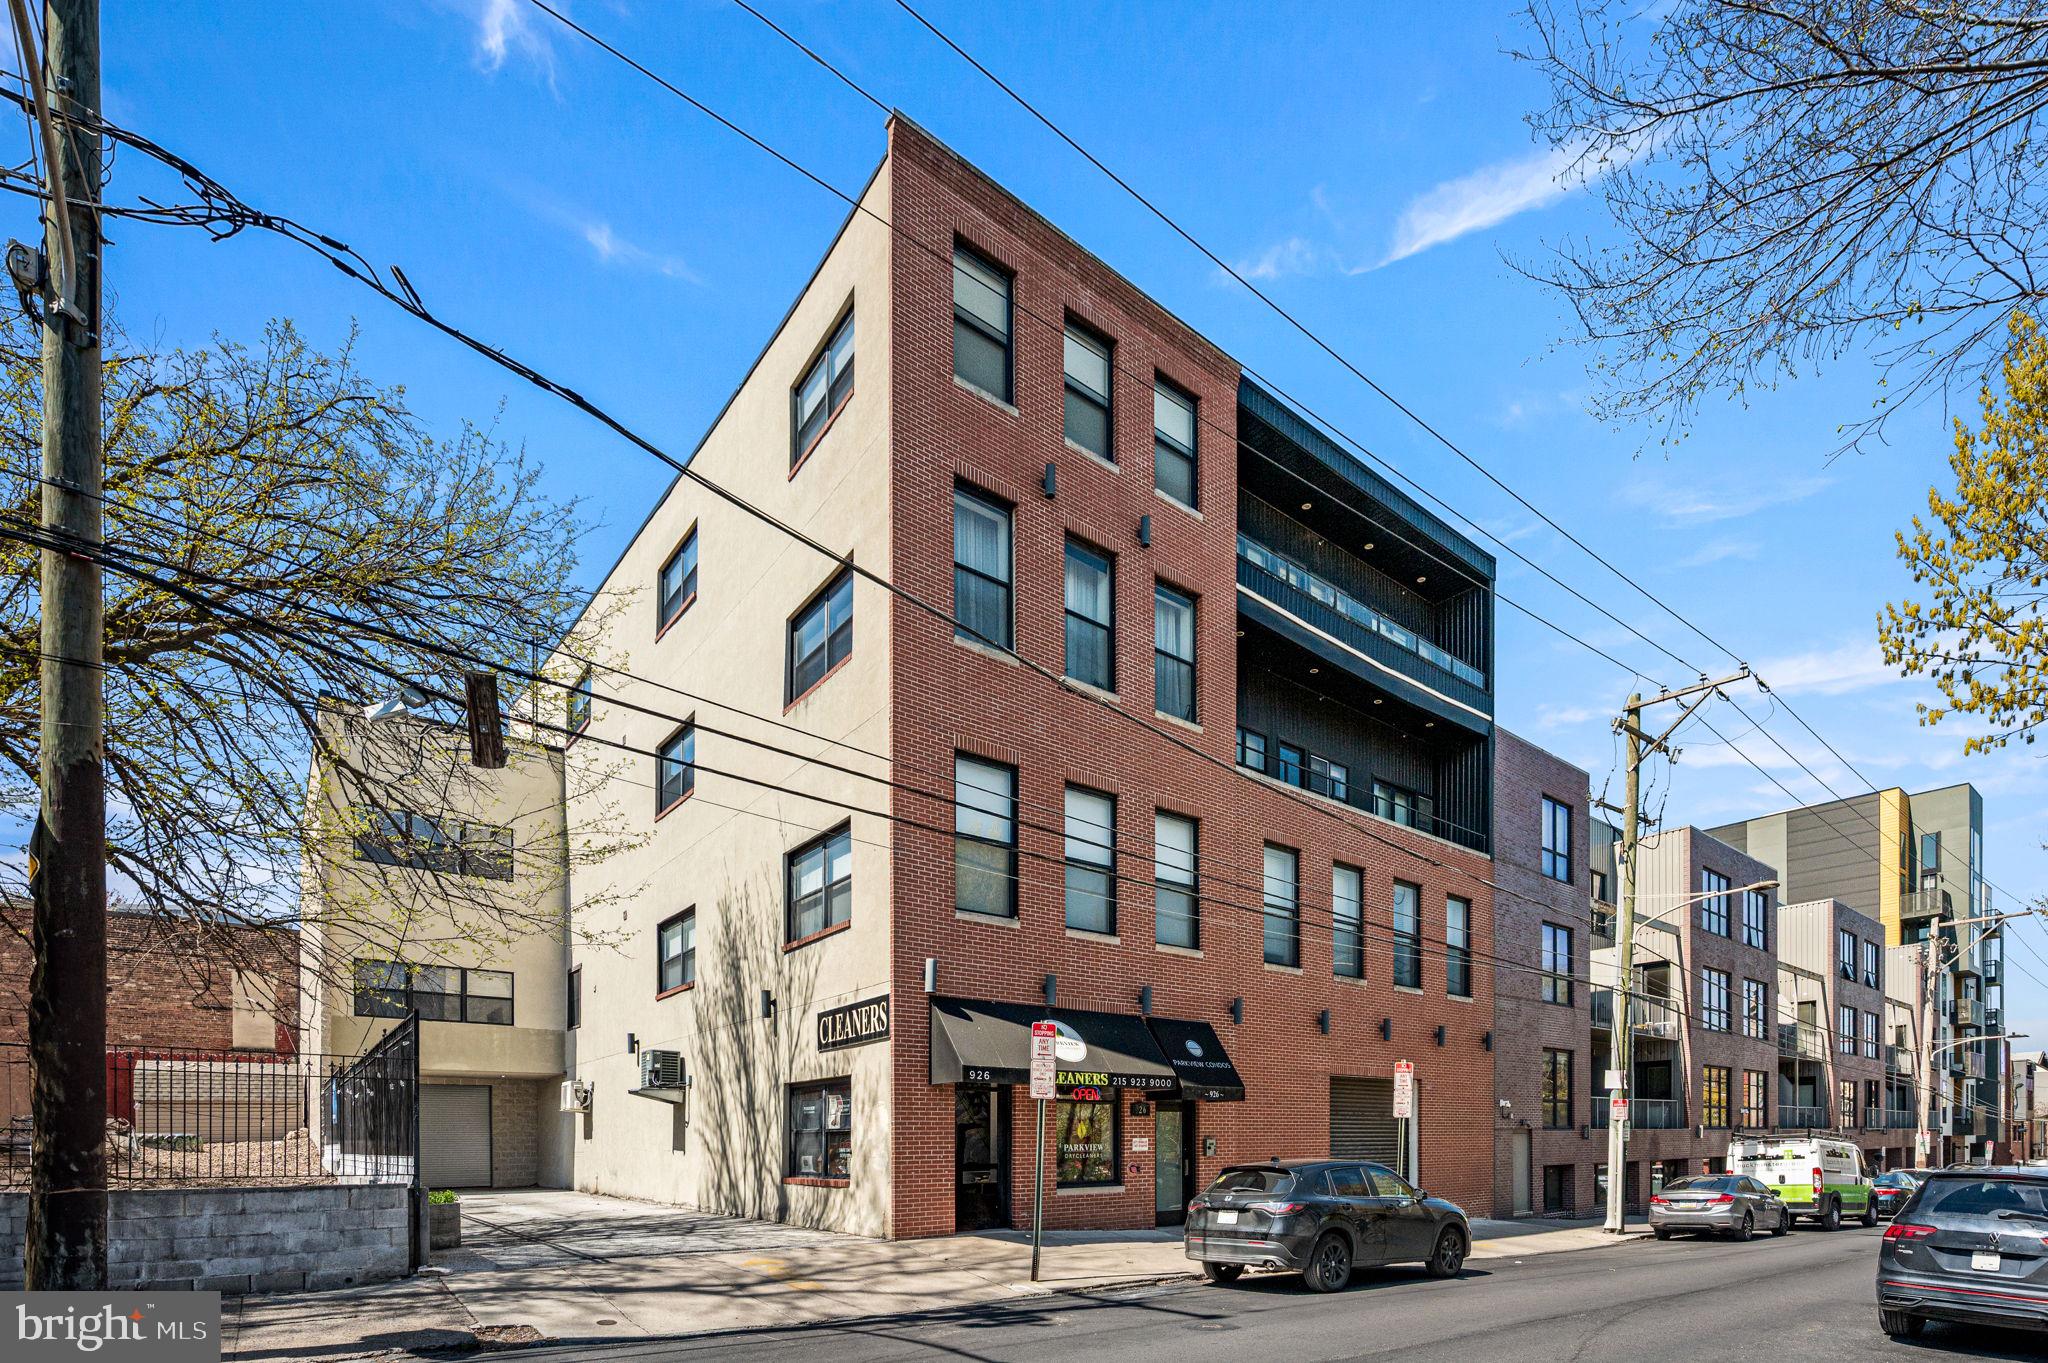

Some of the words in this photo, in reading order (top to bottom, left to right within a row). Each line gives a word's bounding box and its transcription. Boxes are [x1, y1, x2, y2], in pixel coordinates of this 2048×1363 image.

[820, 1001, 888, 1044] CLEANERS
[1172, 1059, 1205, 1068] PARKVIEW
[1205, 1061, 1231, 1069] CONDOS
[969, 1070, 990, 1081] 926
[1055, 1071, 1109, 1086] EANERS
[1112, 1077, 1127, 1086] 215
[1130, 1078, 1146, 1087] 923
[1150, 1079, 1172, 1087] 9000
[1072, 1088, 1100, 1101] OPEN
[1209, 1090, 1220, 1098] 926
[1064, 1143, 1104, 1152] PARKVIEW
